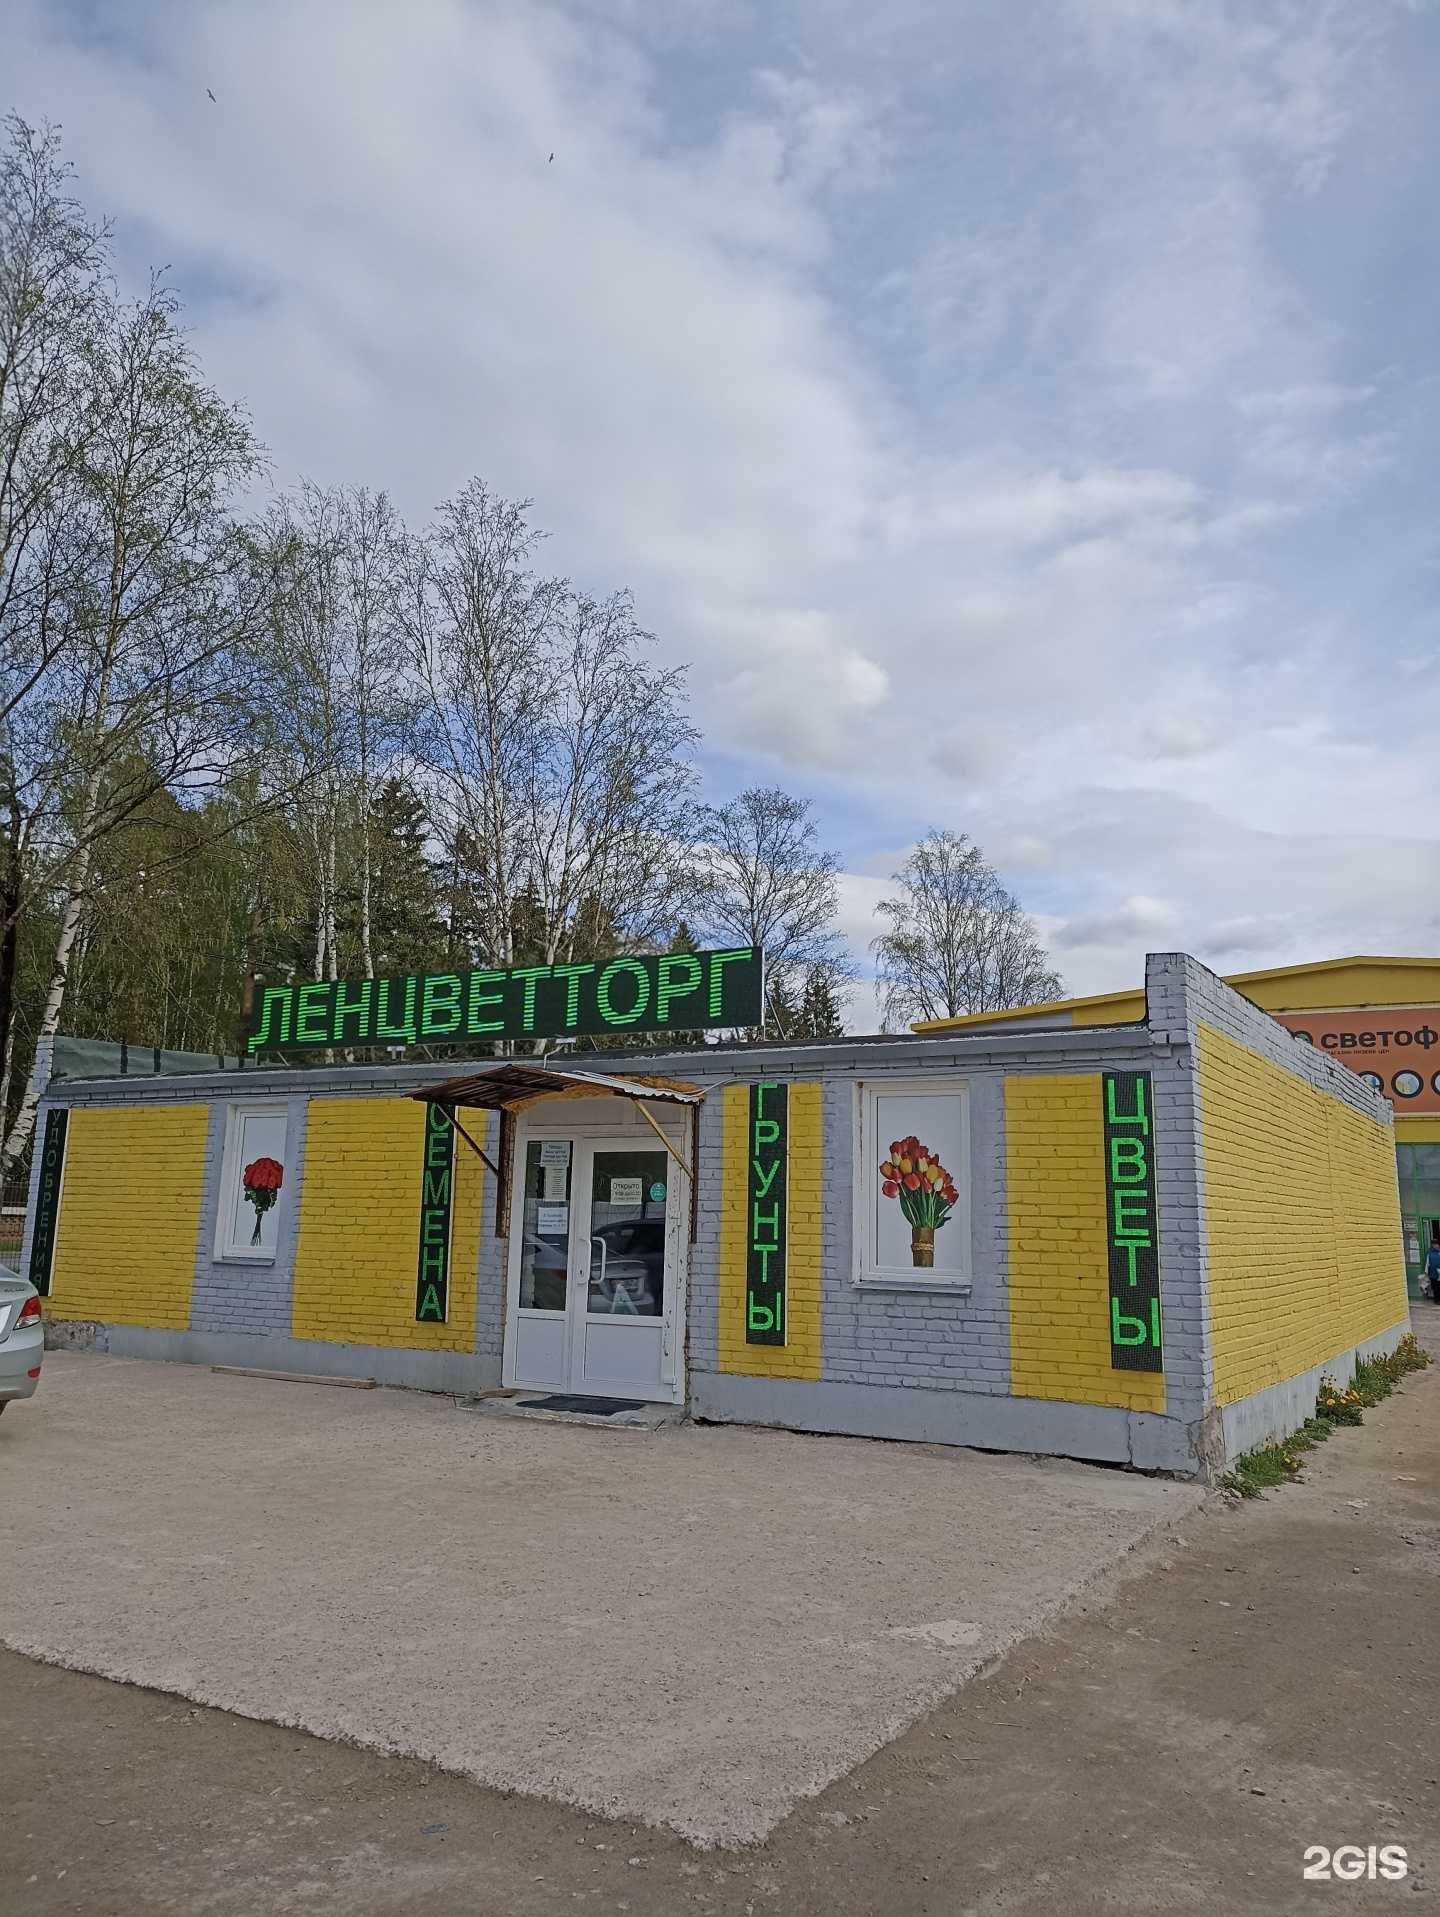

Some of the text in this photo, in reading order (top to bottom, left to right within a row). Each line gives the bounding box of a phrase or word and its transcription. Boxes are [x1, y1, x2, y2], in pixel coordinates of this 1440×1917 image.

[248, 949, 752, 1053] ЛЕНЦВЕТТОРГ
[32, 1110, 61, 1289] УДОБРЕНИЯ
[419, 1102, 452, 1320] СЕМЕНА
[748, 1082, 782, 1332] ГРУНТЫ
[1107, 1078, 1160, 1347] ЦВЕТЫ
